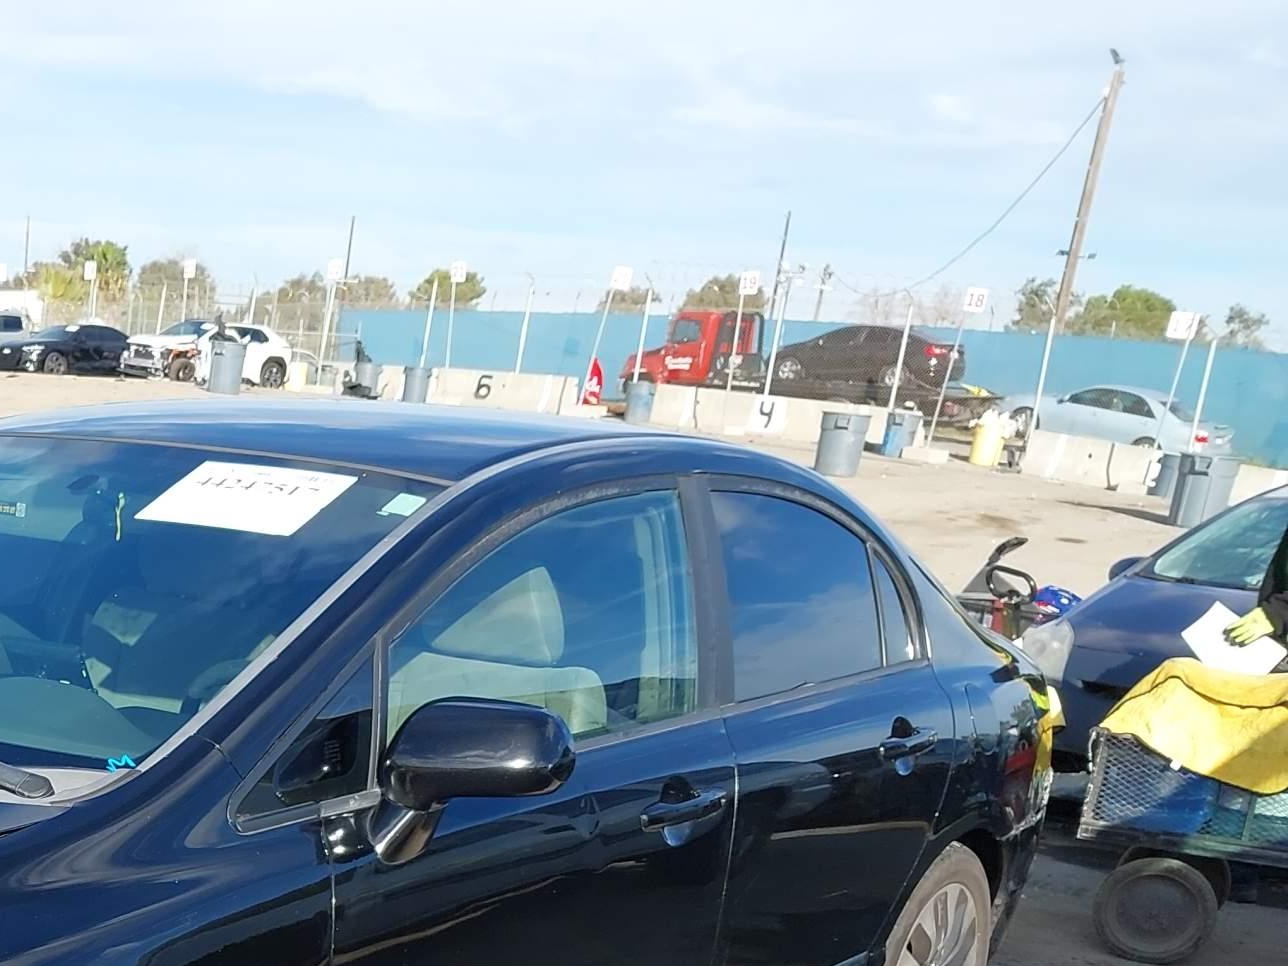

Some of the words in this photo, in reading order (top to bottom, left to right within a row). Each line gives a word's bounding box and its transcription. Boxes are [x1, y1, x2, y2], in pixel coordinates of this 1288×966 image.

[742, 275, 757, 290] 19
[967, 292, 985, 308] 18
[474, 374, 494, 400] 6
[759, 400, 775, 429] 4
